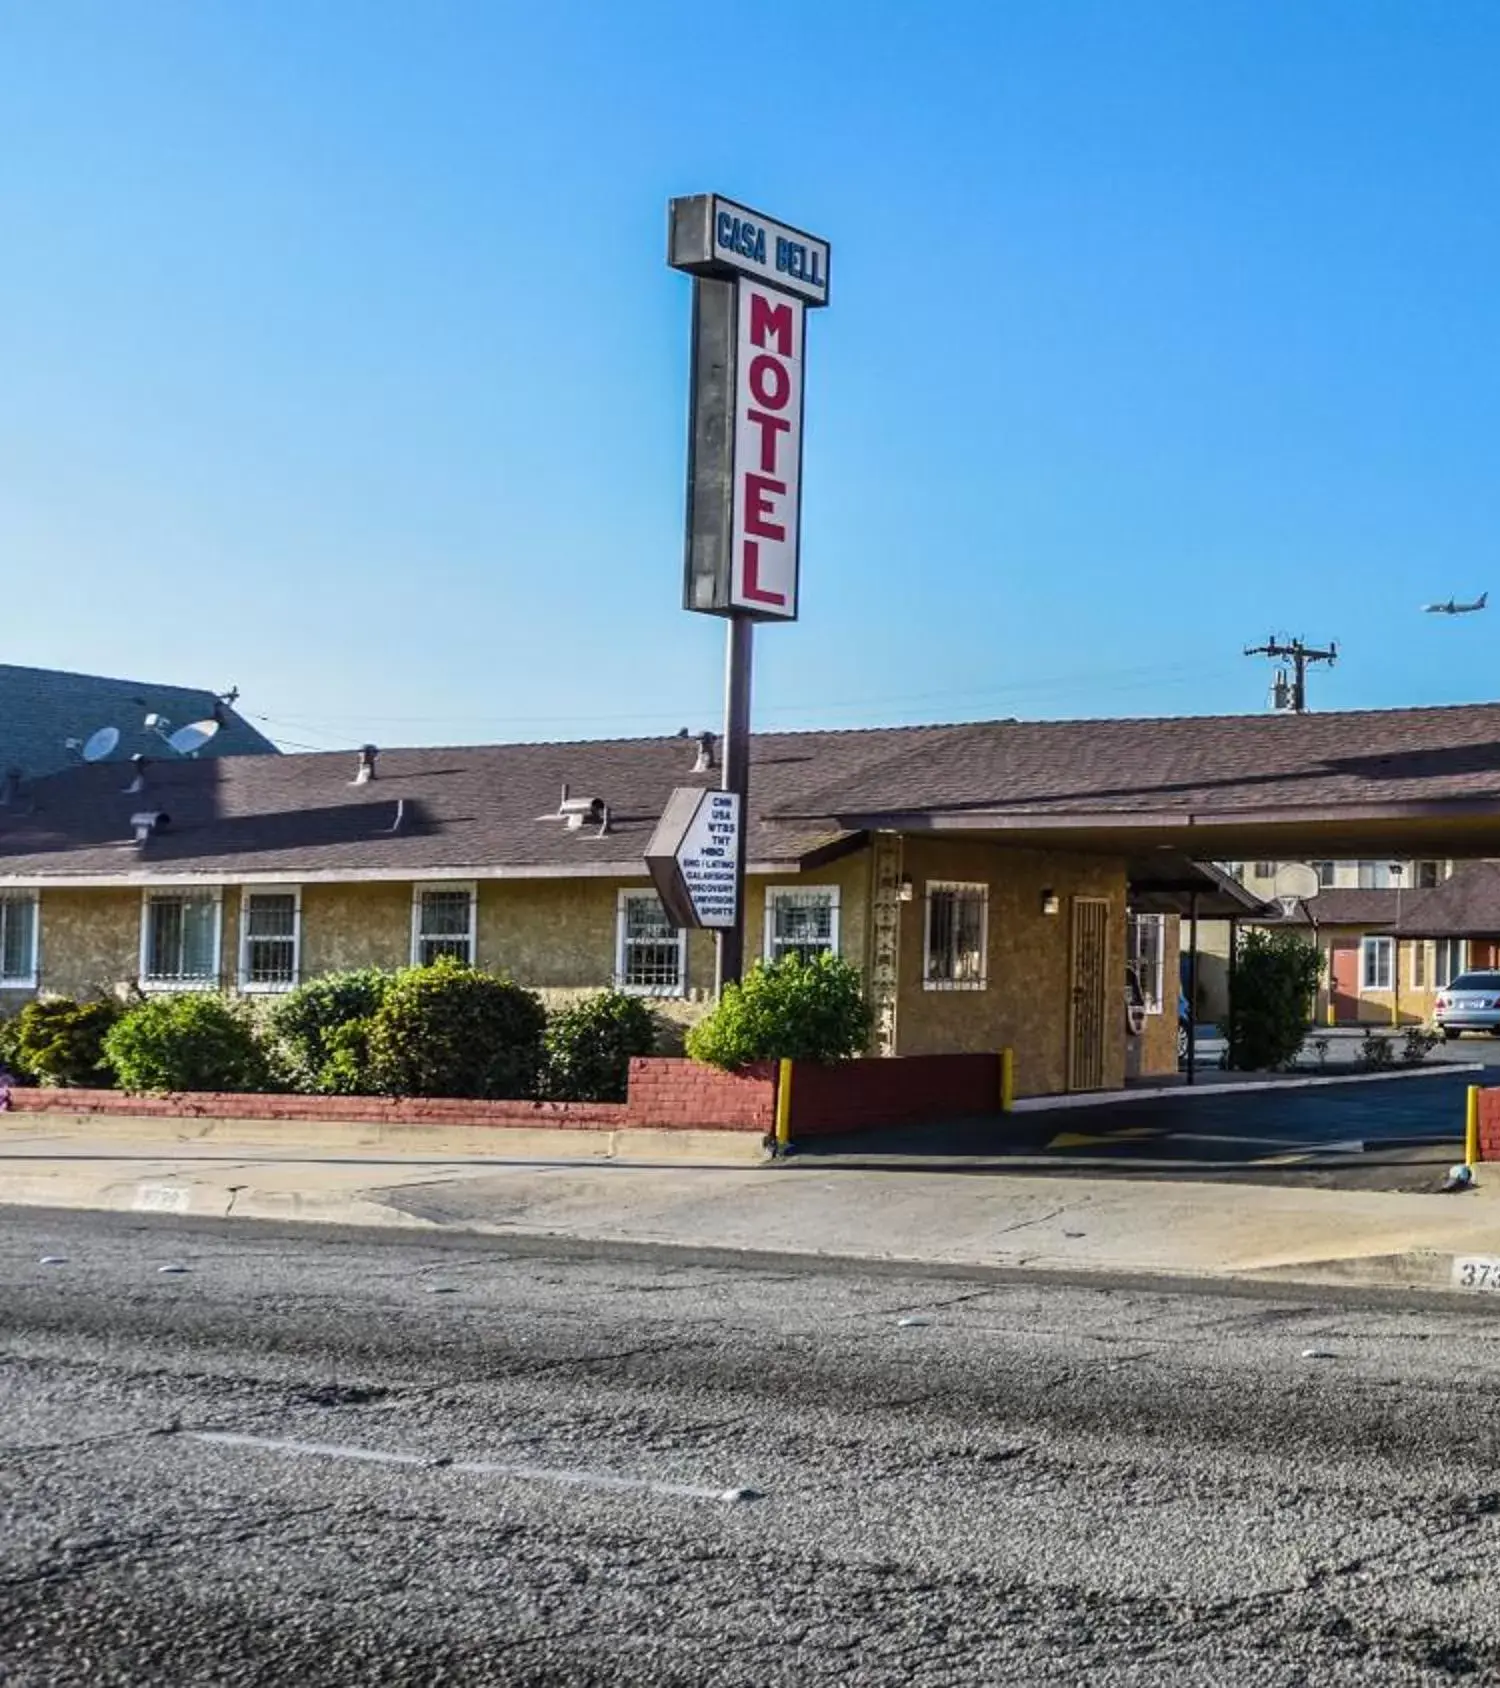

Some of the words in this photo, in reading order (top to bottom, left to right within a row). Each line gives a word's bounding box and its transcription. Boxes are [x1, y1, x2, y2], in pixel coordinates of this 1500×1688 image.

[717, 211, 767, 265] CASA
[776, 236, 825, 288] BELL
[742, 293, 793, 606] MOTEL
[711, 810, 731, 820] USA
